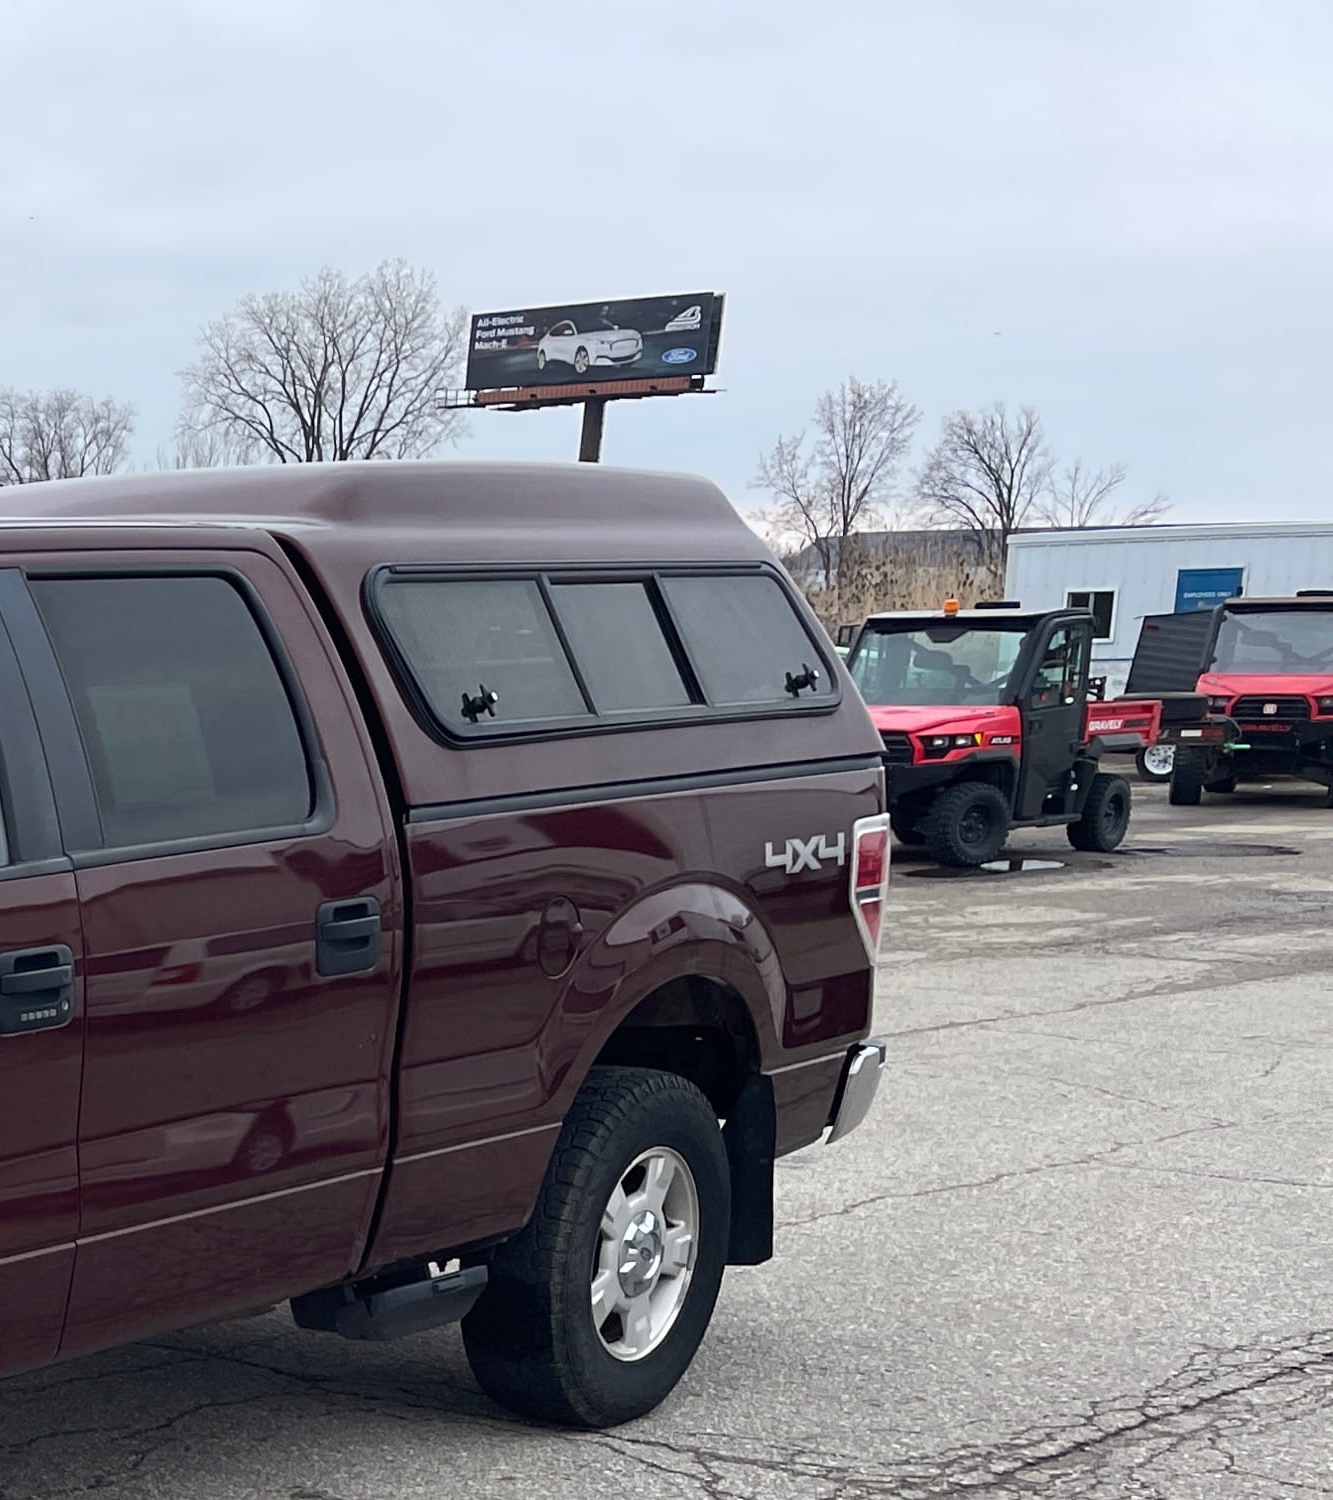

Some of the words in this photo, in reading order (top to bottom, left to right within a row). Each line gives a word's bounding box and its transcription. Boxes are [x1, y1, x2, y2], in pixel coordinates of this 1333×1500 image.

[476, 328, 496, 339] Ford
[497, 326, 535, 337] Mustang
[1088, 719, 1124, 731] GRAVELY
